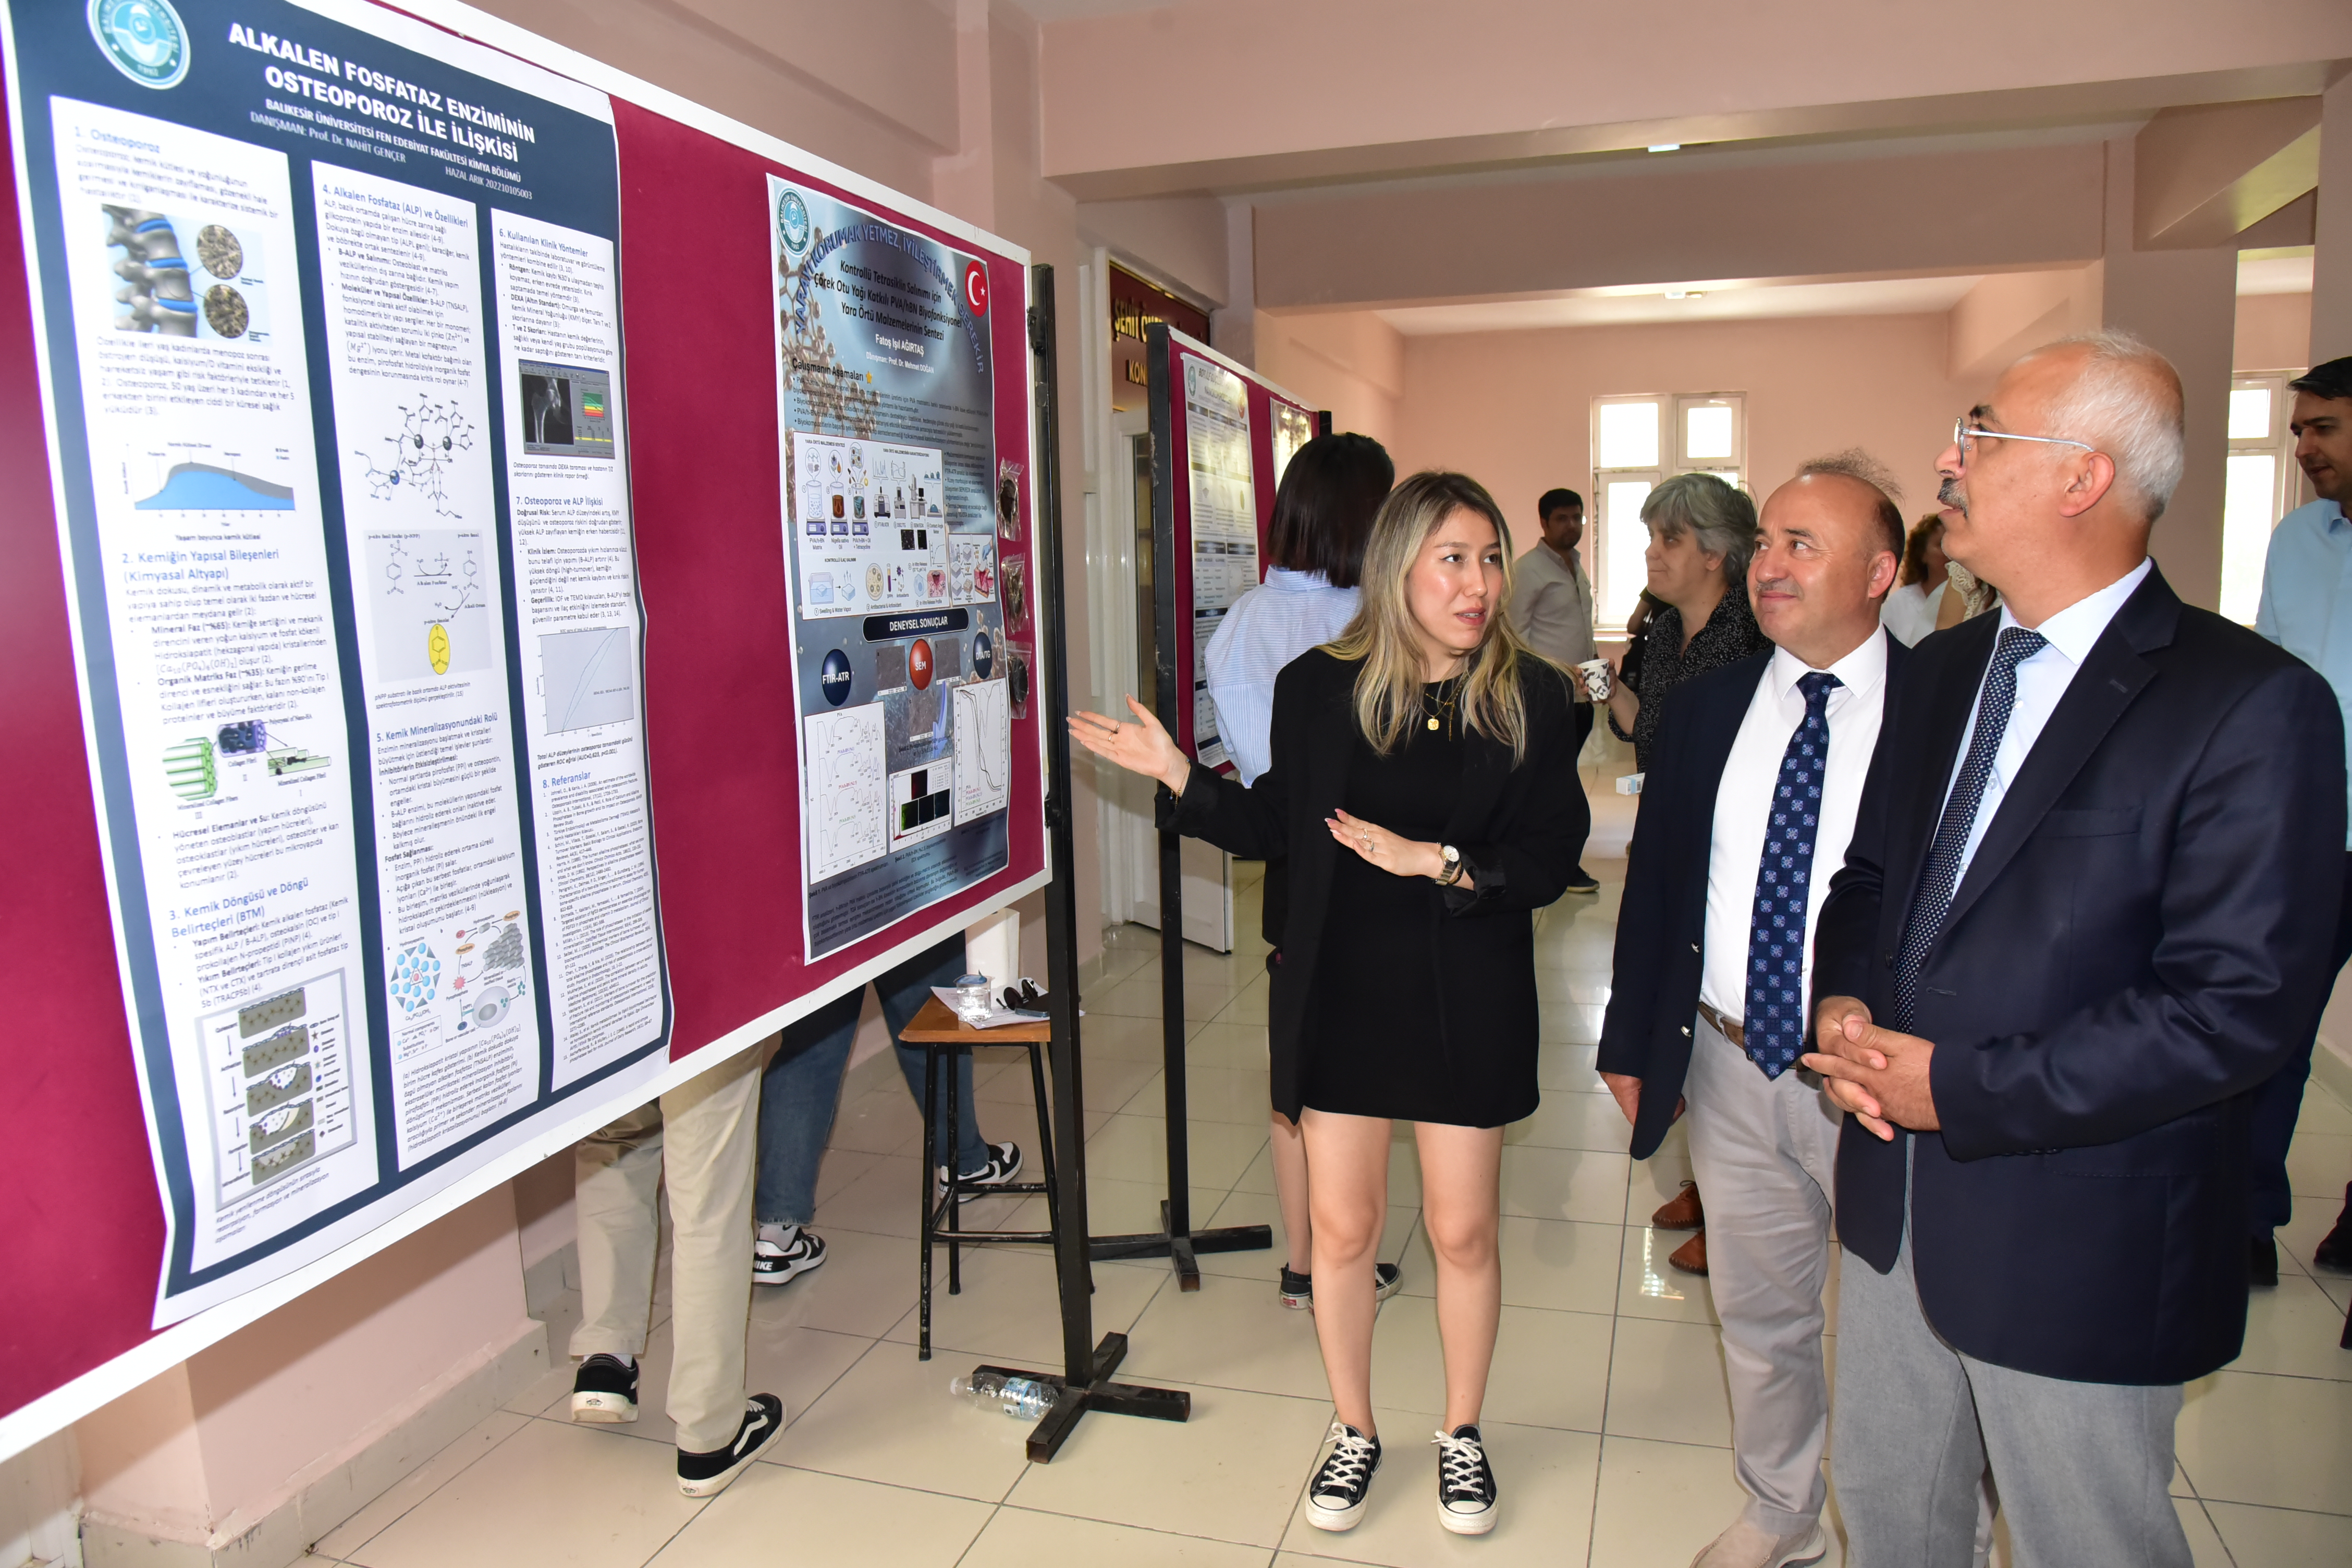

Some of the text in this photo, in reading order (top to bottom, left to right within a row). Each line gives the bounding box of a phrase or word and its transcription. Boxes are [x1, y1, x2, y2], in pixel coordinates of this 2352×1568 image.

[229, 23, 339, 76] ALKALEN
[345, 61, 443, 112] FOSFATAZ
[446, 97, 535, 143] ENZİMİNİN
[265, 66, 518, 162] OSTEOPOROZ İLE İLİŞKİSİ
[91, 129, 160, 153] Osteoporoz
[250, 111, 406, 163] DANIŞMAN: Prof. Dr. NAHİT GENÇER
[266, 98, 521, 183] BALIKESİR ÜNİVERSİTESİ FEN EDEBİYAT FAKÜLTESİ KİMYA BÖLÜMÜ
[445, 165, 532, 200] HAZAL ARIK 202210105003
[323, 184, 330, 193] 4.
[334, 187, 365, 201] Alkalen
[368, 194, 400, 210] Fosfataz
[402, 203, 422, 217] (ALP)
[434, 210, 468, 227] Özellikleri
[499, 228, 588, 256] 6. Kullanılan Klinik Yöntemler
[795, 260, 815, 334] YARAYI
[811, 225, 861, 267] KORUMAK
[861, 225, 901, 252] YETMEZ,
[903, 234, 958, 307] İYİLEŞTİRMEK
[840, 261, 941, 302] Kontrollü Tetrasiklin Salınımı için
[814, 273, 835, 289] Çörek
[837, 280, 849, 293] Otu
[851, 284, 865, 301] Yağı
[867, 289, 889, 305] Katkılı
[918, 305, 962, 328] Biyofonksiyonel
[841, 302, 944, 340] Yara Örtü Malzemelerinin Sentezi
[875, 334, 891, 349] Fatoş
[901, 341, 924, 357] AĞIRTAŞ
[792, 358, 863, 381] Çalışmanın Aşamaları
[524, 496, 562, 506] Osteoporoz
[585, 496, 603, 507] İlişkisi
[122, 549, 278, 564] 2. Kemiğin Yapısal Bileşenleri
[125, 568, 228, 582] (Kimyasal Altyapı)
[889, 616, 948, 631] DENEYSEL SONUÇLAR
[915, 661, 926, 671] SEM
[976, 649, 990, 660] DTA/TG
[822, 671, 849, 684] FTIR-ATR
[376, 712, 497, 742] 5. Kemik Mineralizasyonundaki Rolü
[543, 771, 591, 788] 8. Referanslar
[169, 878, 308, 920] 3. Kemik Döngüsü ve Döngü
[172, 906, 264, 937] Belirteçleri (BTM)
